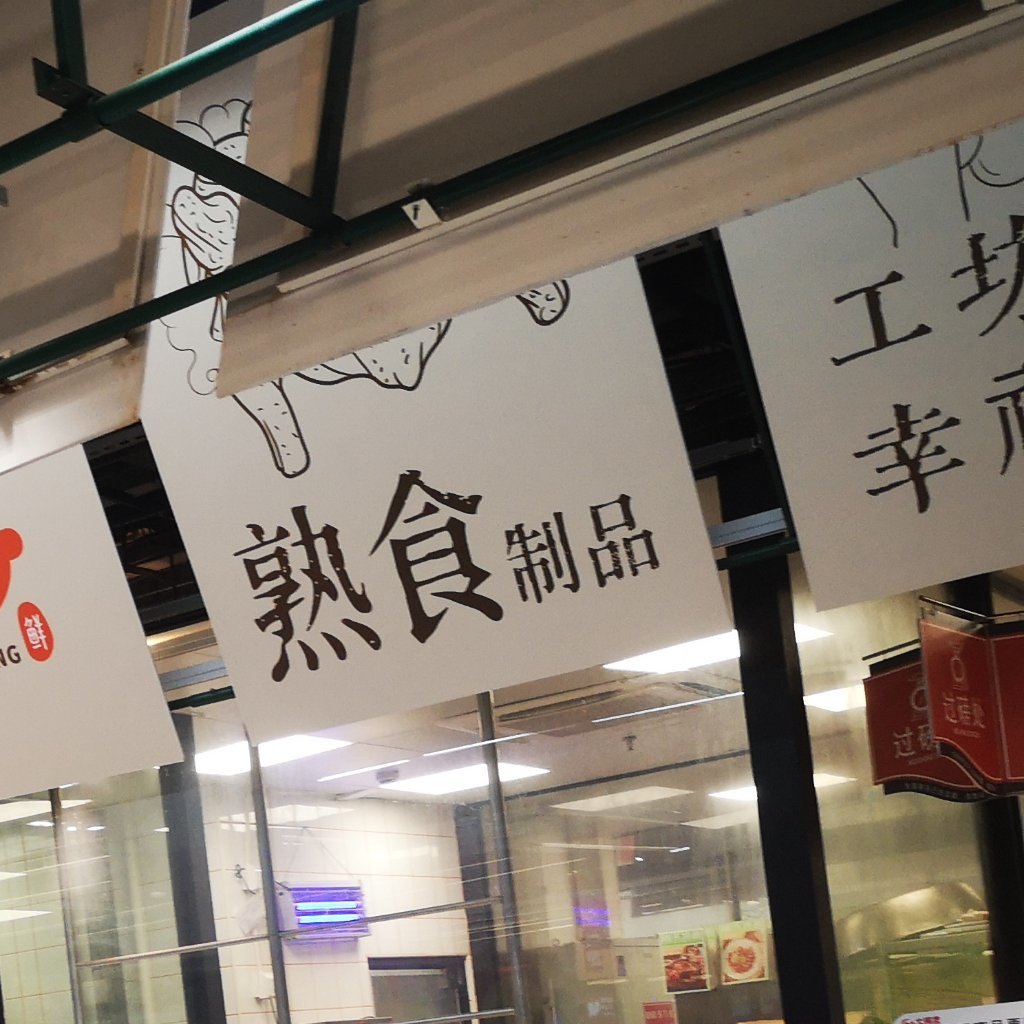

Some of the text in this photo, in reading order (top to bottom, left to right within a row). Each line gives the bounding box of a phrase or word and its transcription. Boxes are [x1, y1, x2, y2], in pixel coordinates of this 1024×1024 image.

[24, 613, 49, 651] 鲜
[232, 470, 660, 682] 熟食制品
